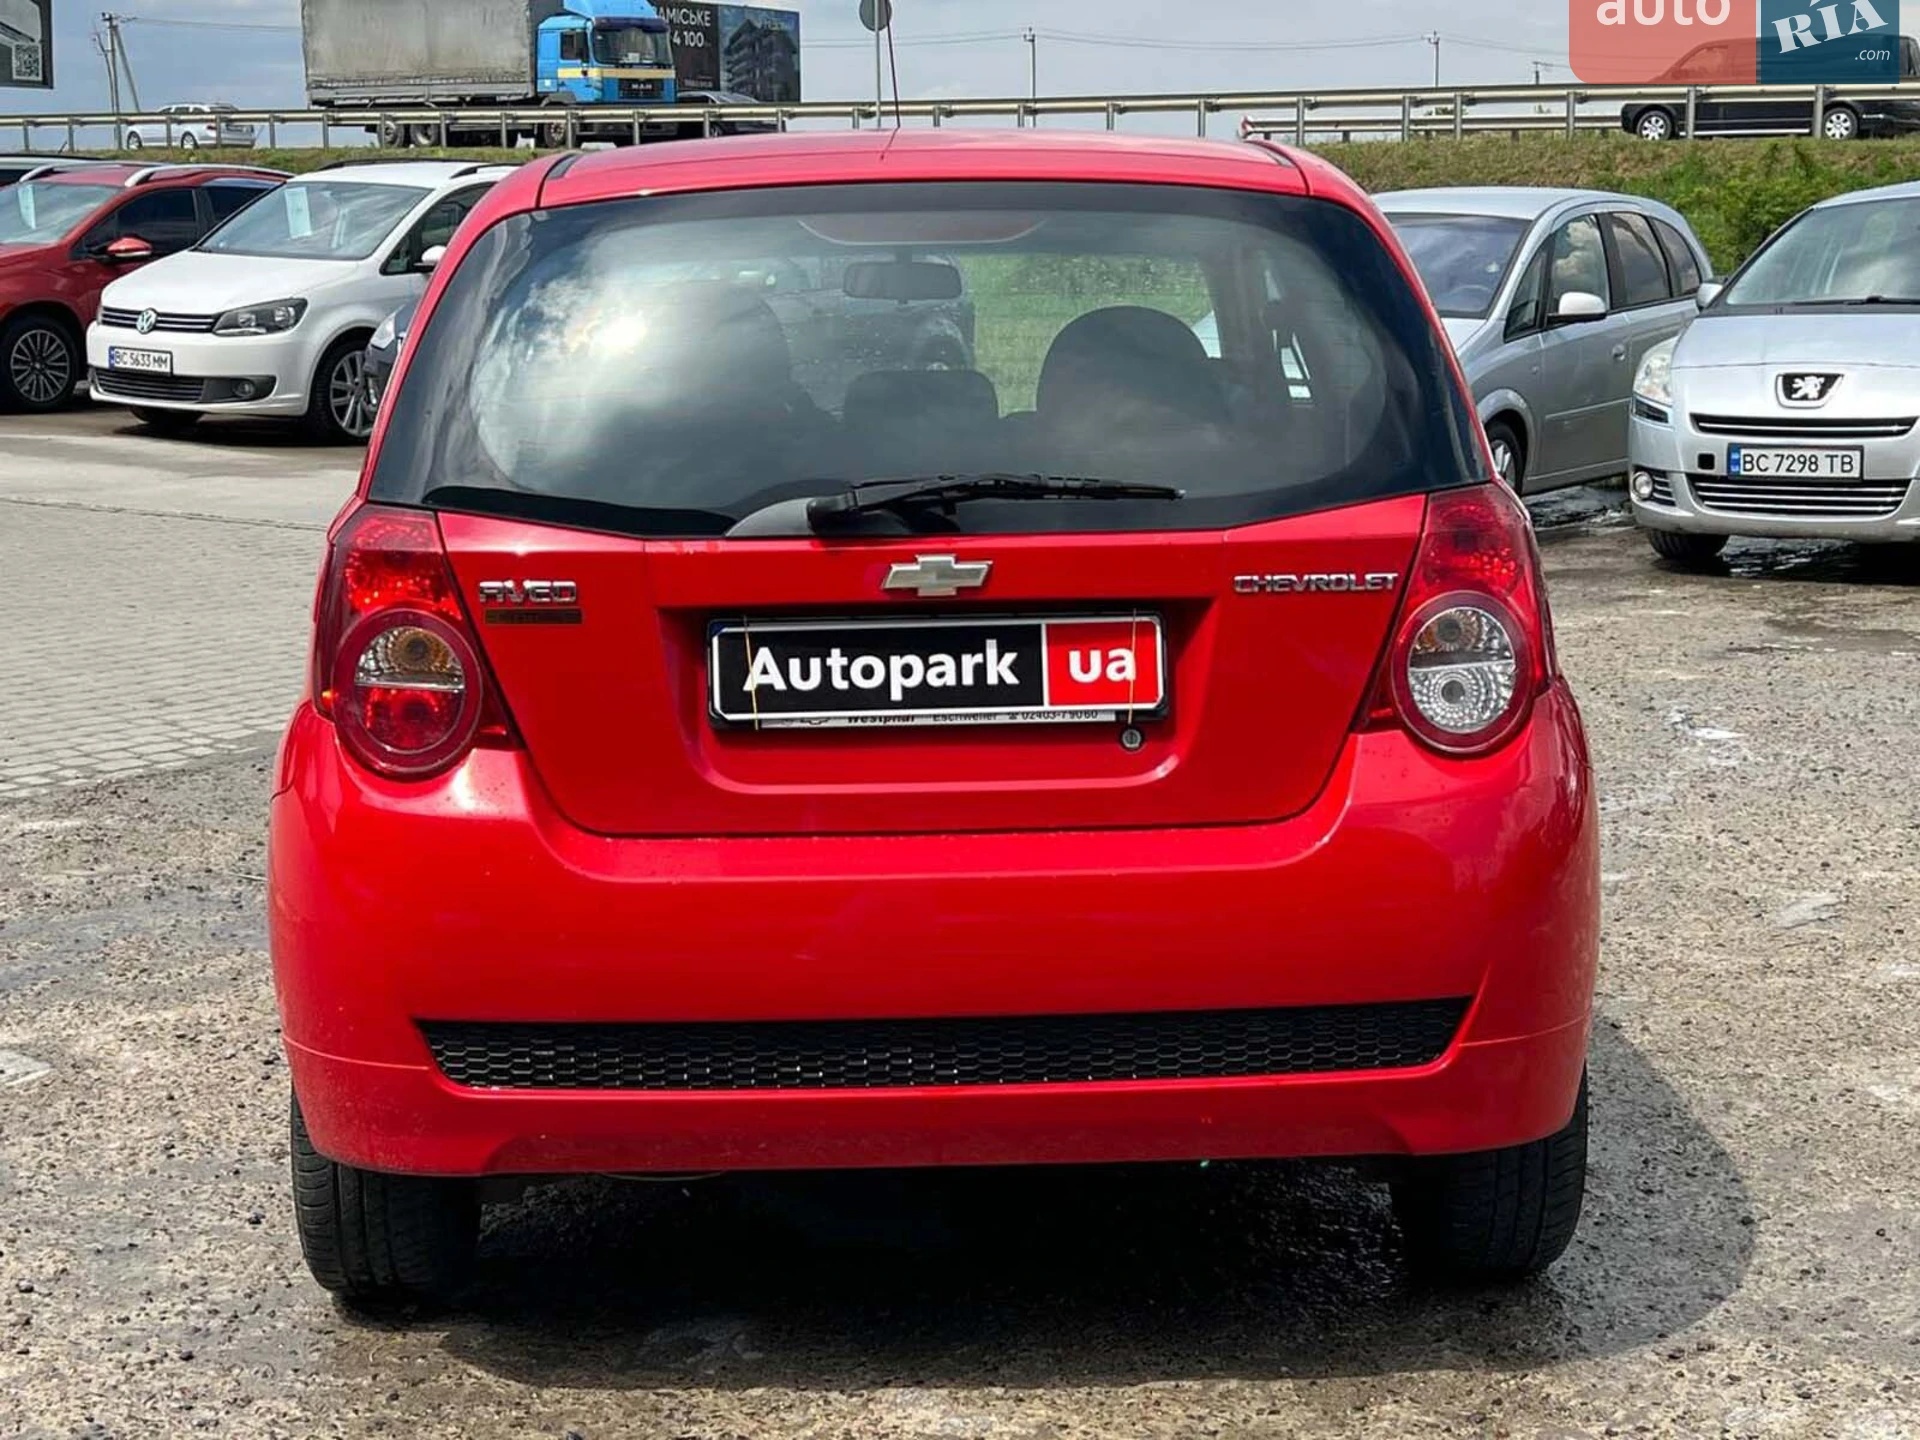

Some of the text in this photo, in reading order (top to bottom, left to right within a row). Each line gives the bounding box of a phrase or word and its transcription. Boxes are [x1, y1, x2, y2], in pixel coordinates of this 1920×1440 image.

[653, 7, 711, 27] АМІСЬКЕ
[683, 31, 704, 48] 100
[114, 350, 169, 369] BC 5633 MM
[1742, 453, 1854, 474] BC 7298 TB
[479, 580, 577, 603] AVEO
[1234, 572, 1399, 593] CHEVROLET
[742, 638, 1137, 701] Autopark ua
